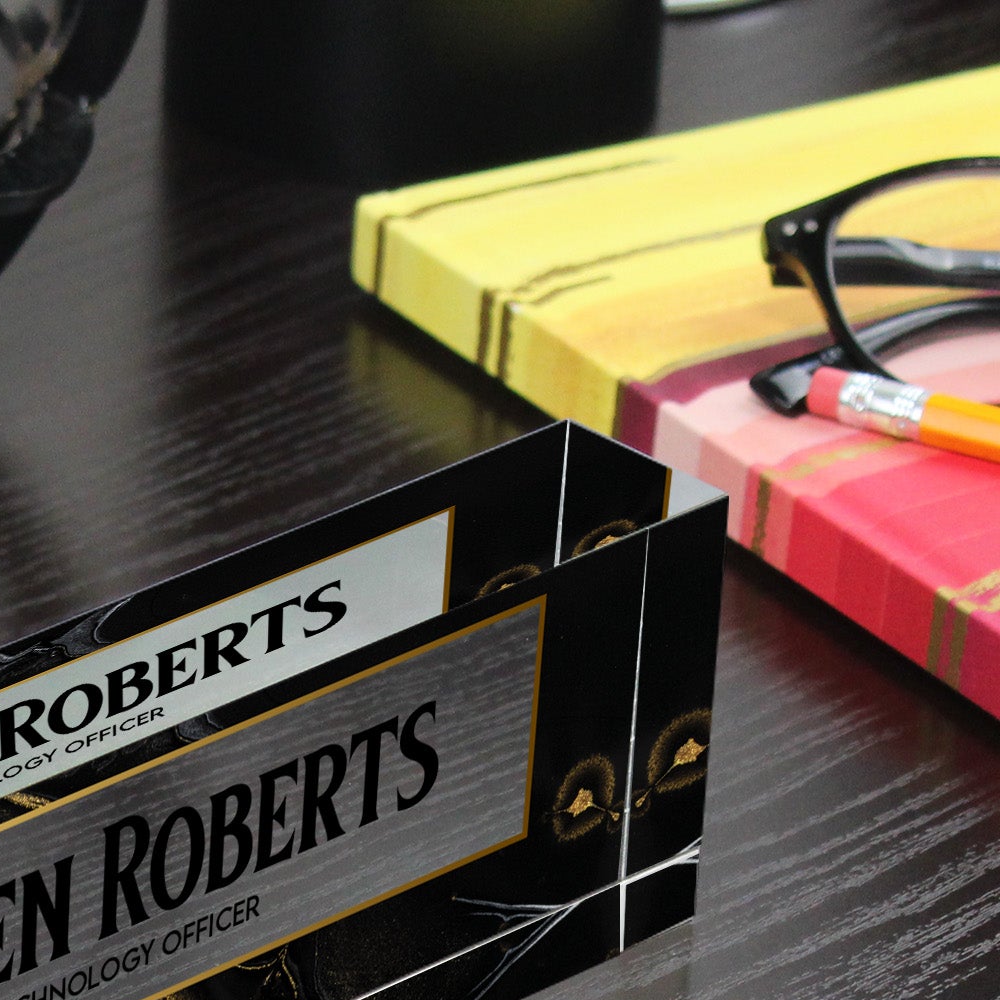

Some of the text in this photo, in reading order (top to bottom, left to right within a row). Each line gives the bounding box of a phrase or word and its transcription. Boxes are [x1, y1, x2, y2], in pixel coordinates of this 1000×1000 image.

[65, 706, 165, 754] OFFICER
[98, 701, 441, 941] ROBERTS
[161, 894, 261, 956] OFFICER
